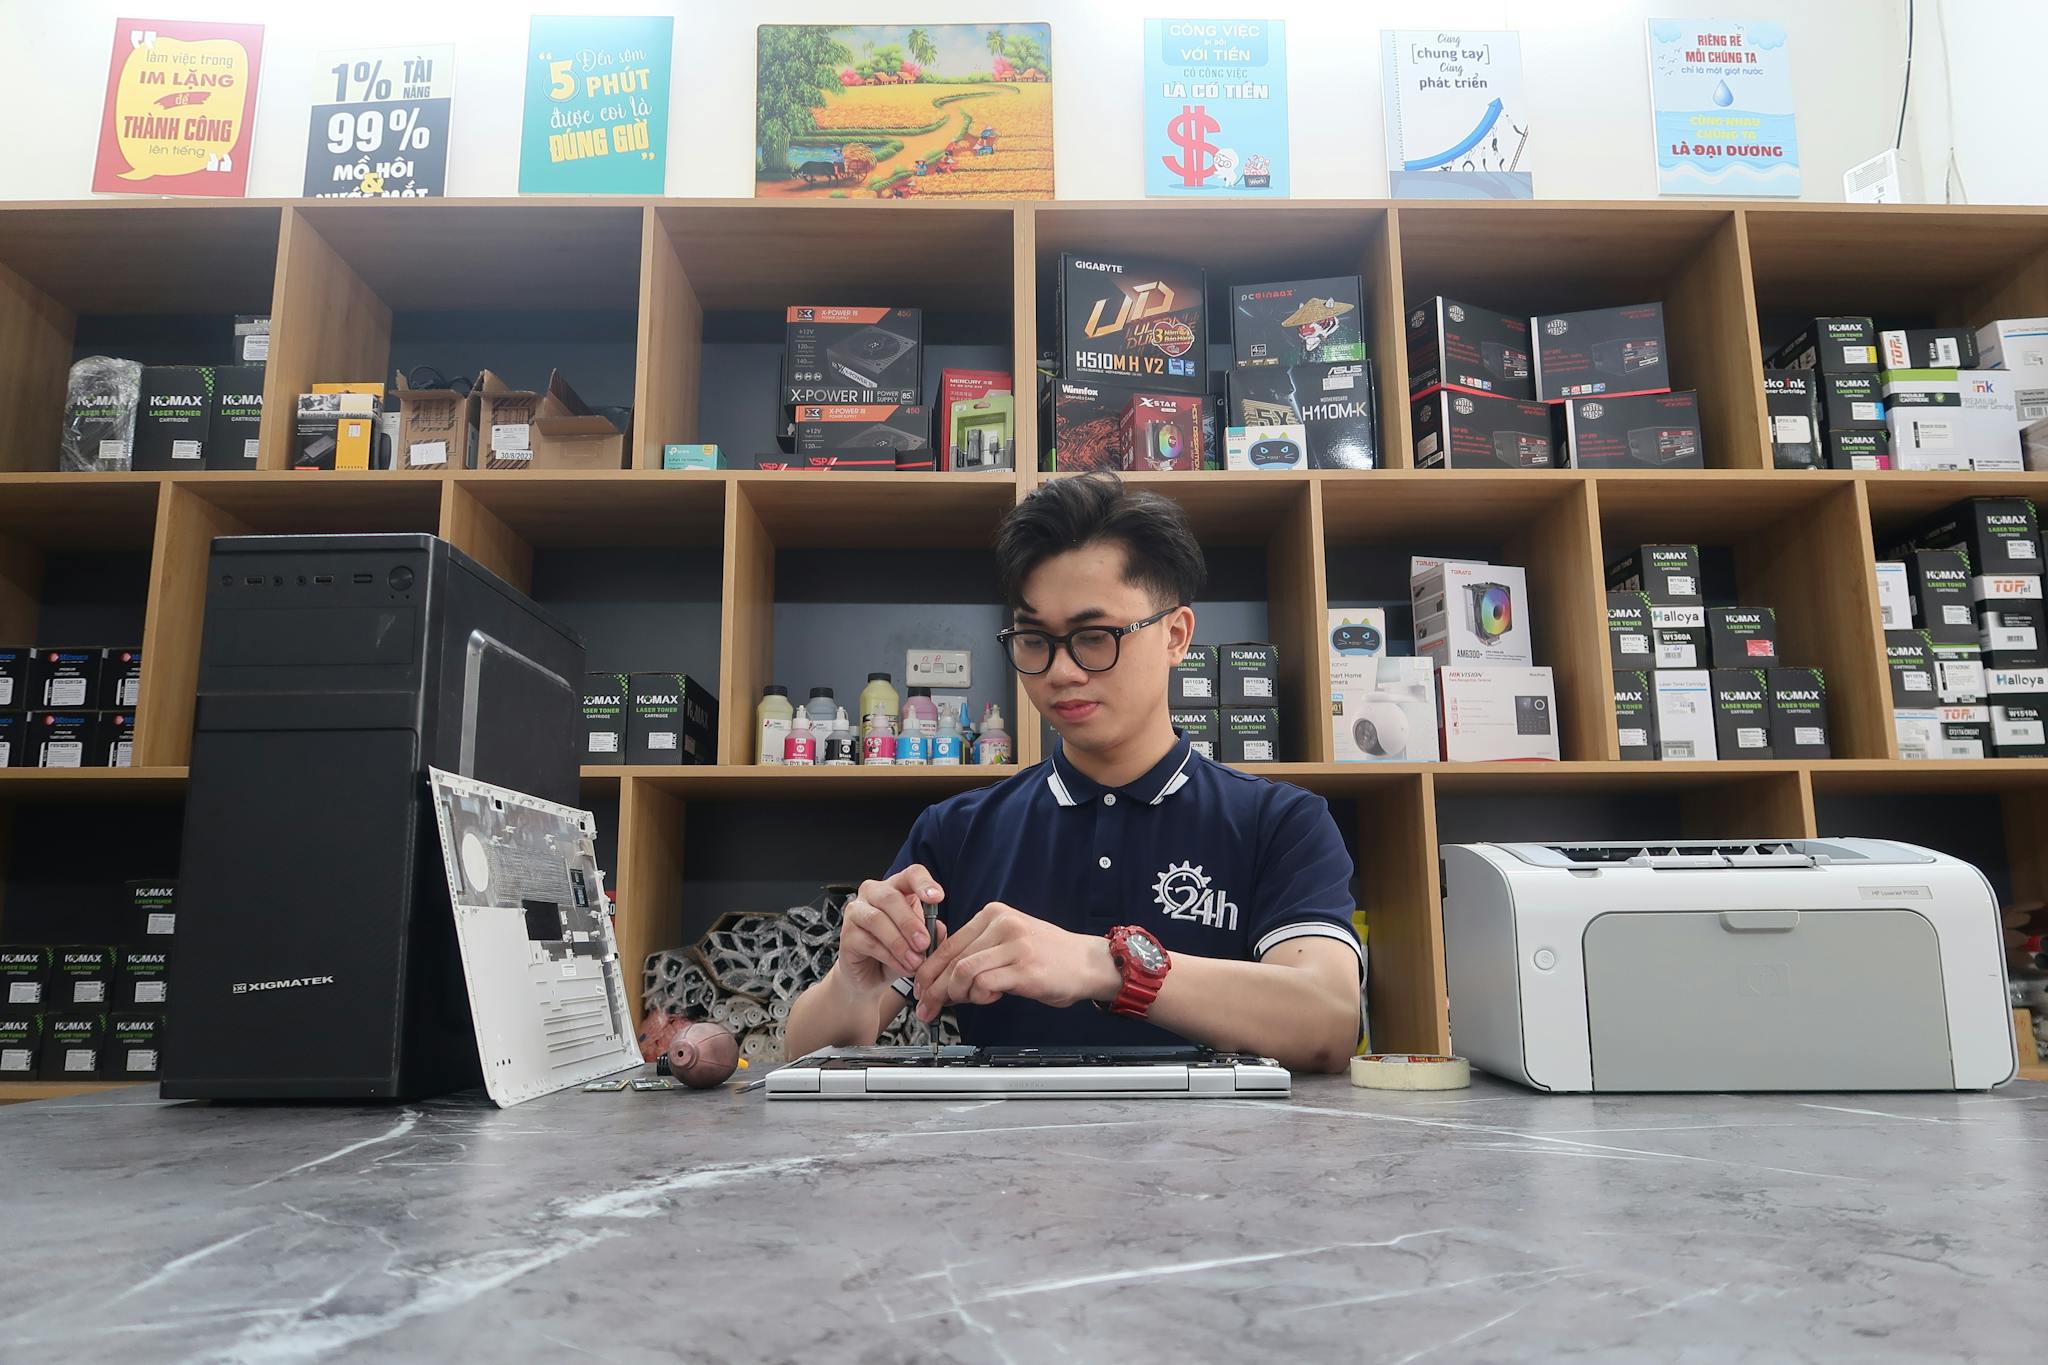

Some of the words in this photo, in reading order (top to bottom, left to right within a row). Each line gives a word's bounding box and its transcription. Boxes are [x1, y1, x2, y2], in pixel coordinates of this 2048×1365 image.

[1169, 22, 1217, 37] CÔNG
[1222, 24, 1260, 39] VIỆC
[1697, 34, 1727, 47] RIÊNG
[146, 51, 168, 64] làm
[173, 51, 198, 66] việc
[201, 54, 233, 68] trong
[1181, 48, 1208, 61] VỚI
[1708, 50, 1743, 64] CHÚNG
[1744, 52, 1758, 64] TA
[403, 56, 433, 83] TÀI
[1199, 67, 1224, 78] CÔNG
[1227, 69, 1248, 80] VIỆC
[139, 71, 166, 85] IM
[173, 69, 235, 90] LẶNG
[586, 66, 650, 98] PHÚT
[1419, 77, 1451, 91] phát
[1455, 73, 1488, 89] triển
[403, 86, 430, 100] NĂNG
[1163, 81, 1187, 98] LÀ
[1191, 81, 1219, 98] CÓ
[550, 107, 594, 129] được
[600, 103, 626, 121] coi
[630, 96, 652, 117] là
[124, 112, 179, 140] THÀNH
[184, 115, 233, 143] CÔNG
[549, 129, 608, 163] ĐÚNG
[613, 119, 649, 153] GIỜ
[149, 145, 170, 156] lên
[173, 144, 206, 159] tiếng
[1671, 140, 1690, 156] LÀ
[1692, 144, 1722, 158] ĐẠI
[1726, 144, 1783, 157] DƯƠNG
[376, 156, 414, 178] HÔI
[360, 173, 384, 193] &
[1075, 260, 1123, 273] GIGABYTE
[1828, 323, 1863, 332] KOMAX
[1155, 329, 1164, 343] 3
[1076, 350, 1126, 371] H510M
[1129, 355, 1139, 372] H
[1143, 357, 1164, 375] V2
[1328, 364, 1363, 375] ASUS
[1061, 383, 1099, 397] Winnfox
[1836, 379, 1870, 388] KOMAX
[77, 395, 127, 408] KOMAX
[150, 395, 202, 407] KOMAX
[222, 394, 264, 406] KOMA
[791, 389, 858, 403] X-POWER
[862, 390, 874, 403] III
[149, 409, 175, 417] LASER
[175, 409, 202, 417] TONER
[1302, 402, 1367, 422] H110M-K
[1841, 436, 1876, 445] KOMAX
[1987, 515, 2028, 524] KOMAX
[1653, 552, 1688, 560] KOMAX
[1926, 571, 1966, 580] KOMAX
[1608, 609, 1642, 618] OMAX
[1653, 610, 1699, 624] Halloya
[1726, 615, 1761, 623] KOMAX
[1184, 652, 1205, 660] MAX
[1231, 651, 1266, 660] KOMAX
[1997, 674, 2044, 688] Halloya
[636, 695, 678, 705] KOMAX
[1616, 692, 1642, 701] MAX
[1720, 691, 1761, 701] KOMAX
[1776, 691, 1820, 700] KOMAX
[1171, 715, 1207, 723] KOMAX
[1231, 714, 1266, 723] KOMAX
[135, 888, 173, 897] KOMAX
[1171, 885, 1239, 931] 24h
[1, 954, 39, 963] KOMAX
[65, 954, 103, 963] KOMAX
[127, 954, 166, 963] KOMAX
[248, 976, 334, 991] XIGMATEK
[54, 1022, 93, 1031] KOMAX
[117, 1022, 154, 1031] KOMAX
